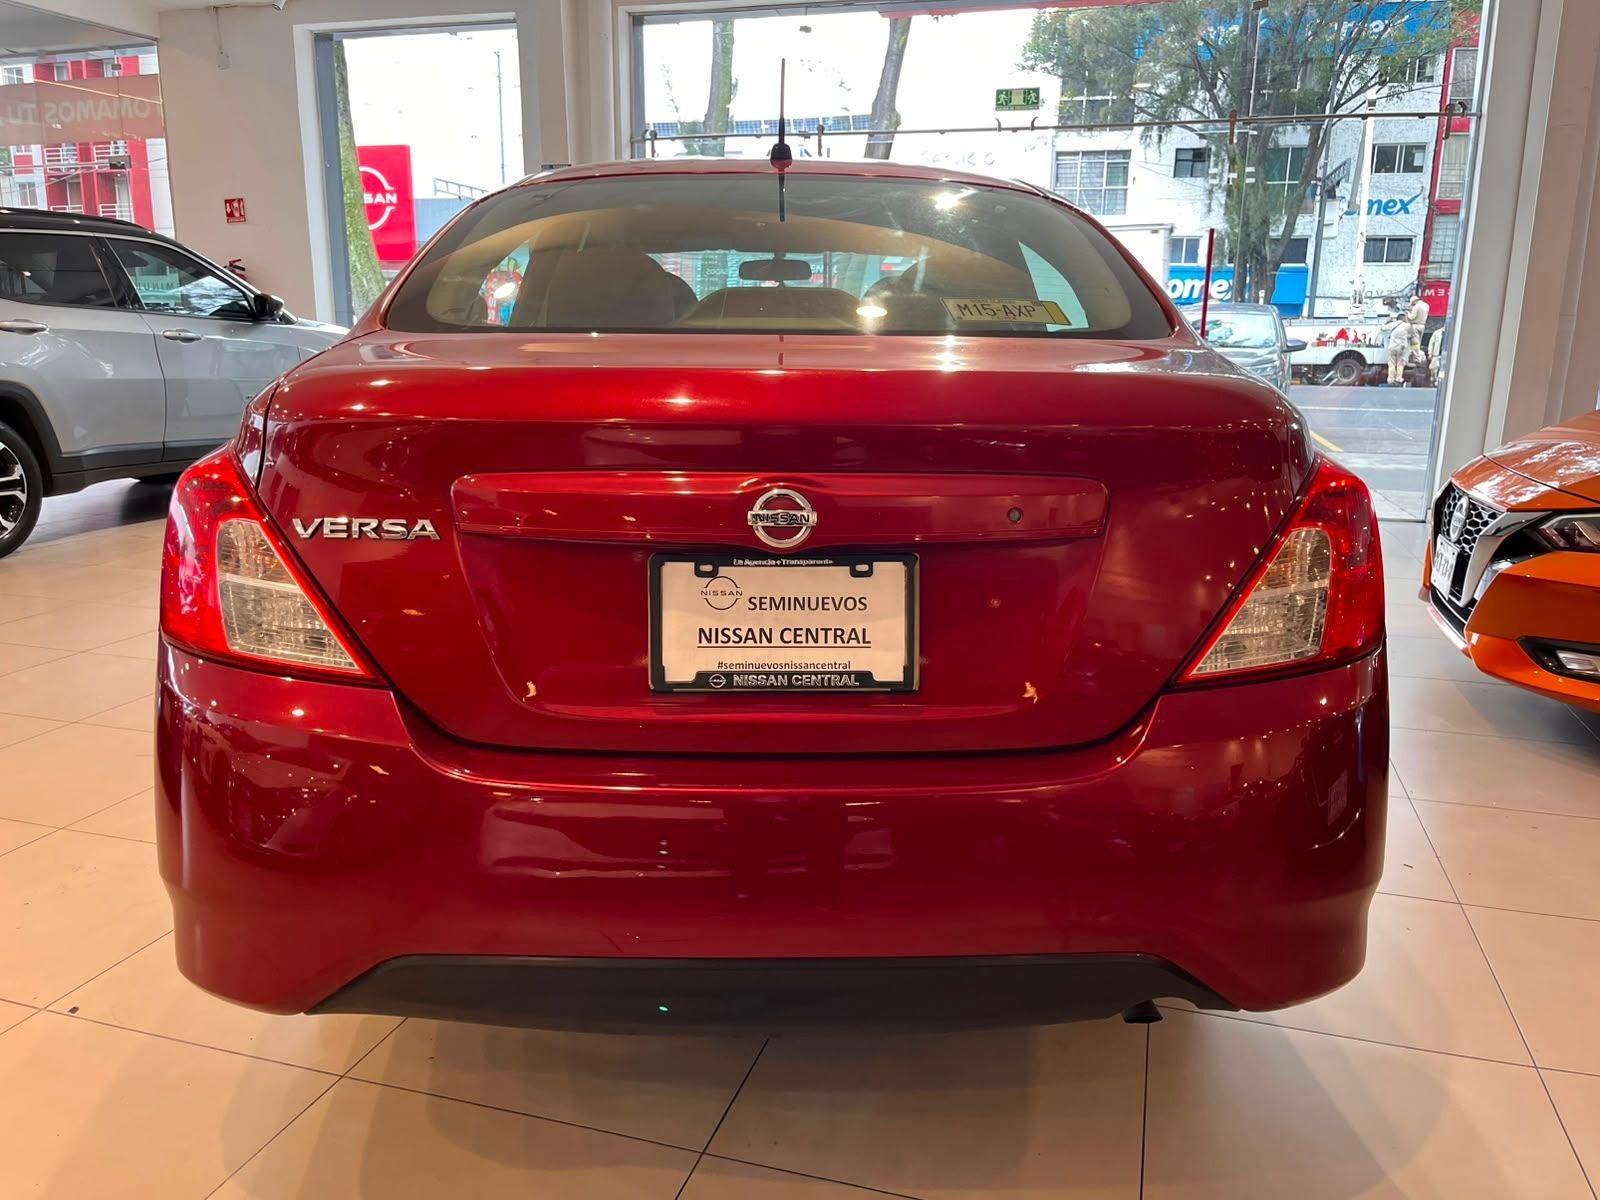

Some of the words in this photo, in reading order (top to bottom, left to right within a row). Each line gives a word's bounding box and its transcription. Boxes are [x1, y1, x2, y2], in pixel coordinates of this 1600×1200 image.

[363, 193, 397, 204] SAN
[755, 512, 810, 523] NISSAN
[291, 516, 441, 540] VERSA
[747, 596, 868, 611] SEMINUEVOS
[698, 627, 773, 644] NISSAN
[779, 627, 872, 644] CENTRAL
[717, 660, 851, 670] #seminuevosnissancentral
[733, 674, 788, 687] NISSAN
[791, 674, 860, 687] CENTRAL
